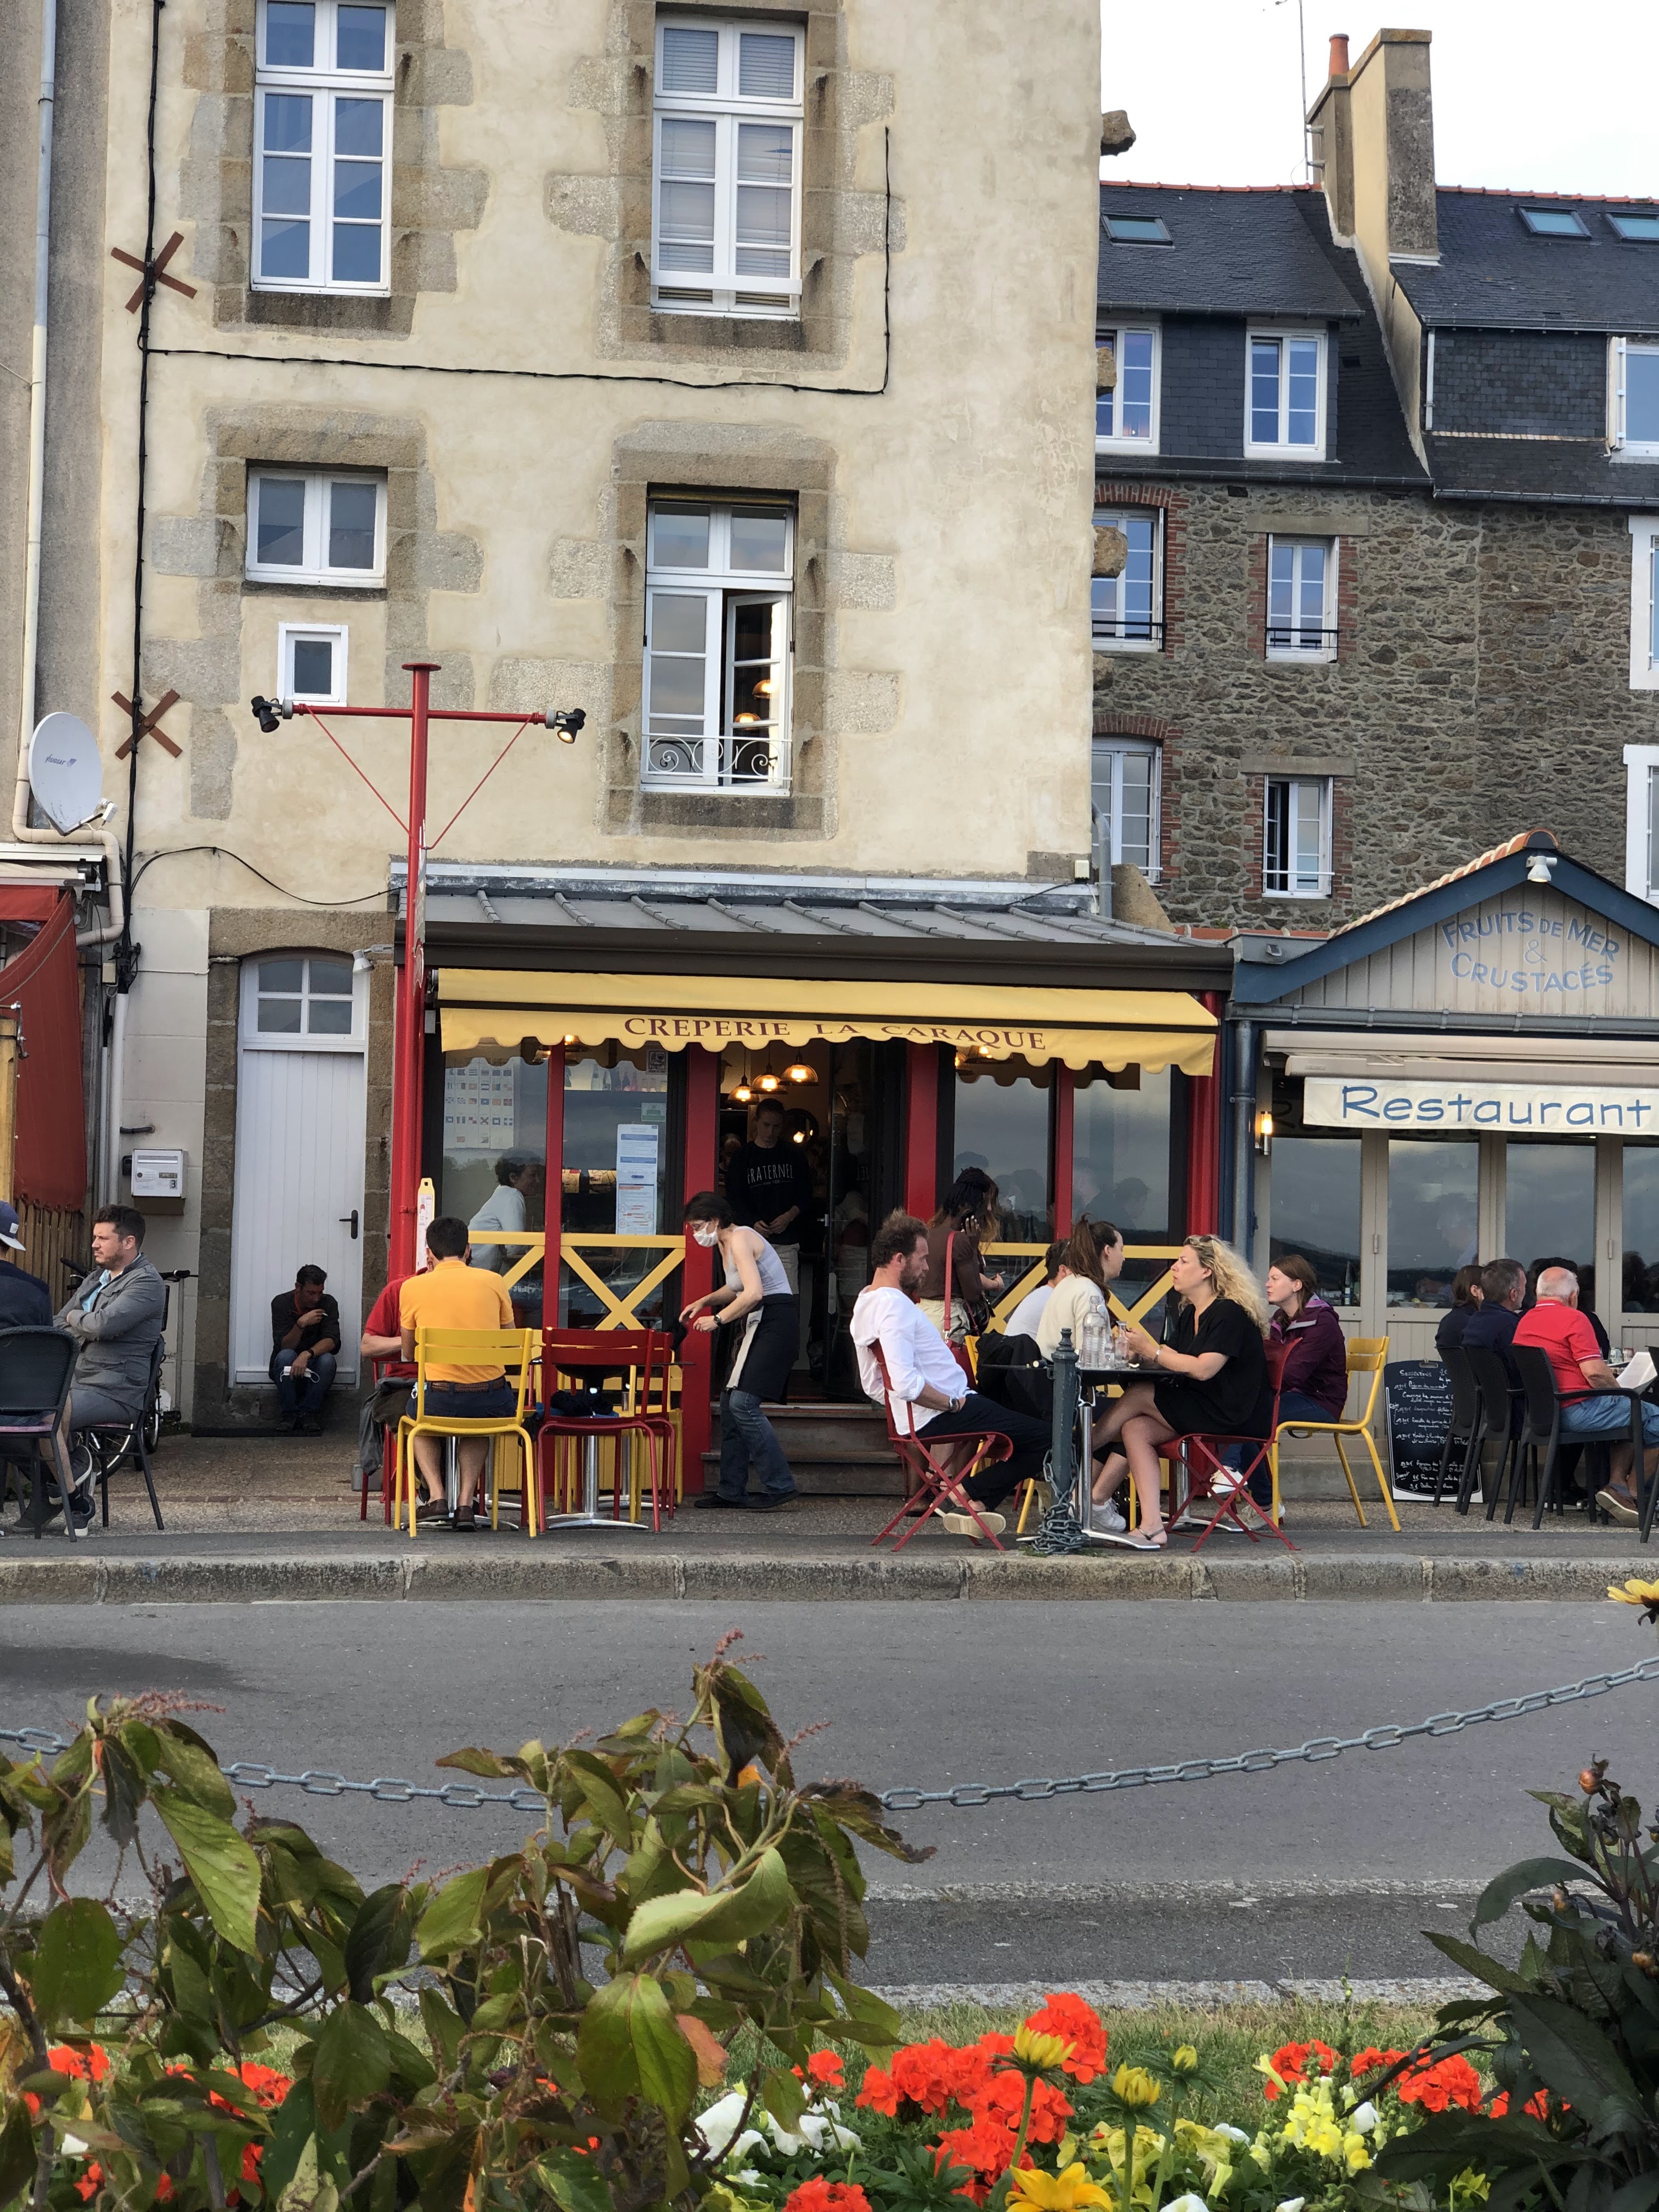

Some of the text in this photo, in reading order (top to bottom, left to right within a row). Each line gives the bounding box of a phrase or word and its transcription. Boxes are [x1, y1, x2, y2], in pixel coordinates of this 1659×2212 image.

[1441, 911, 1620, 963] FRUITS DE MER
[1523, 939, 1548, 964] &
[1450, 951, 1614, 993] CRUSTACÉS
[624, 1017, 1047, 1050] CREPERIE LA CARAQUE
[1342, 1086, 1651, 1127] Restaurant
[171, 1180, 176, 1188] 3
[747, 1164, 794, 1184] FRATERNEL
